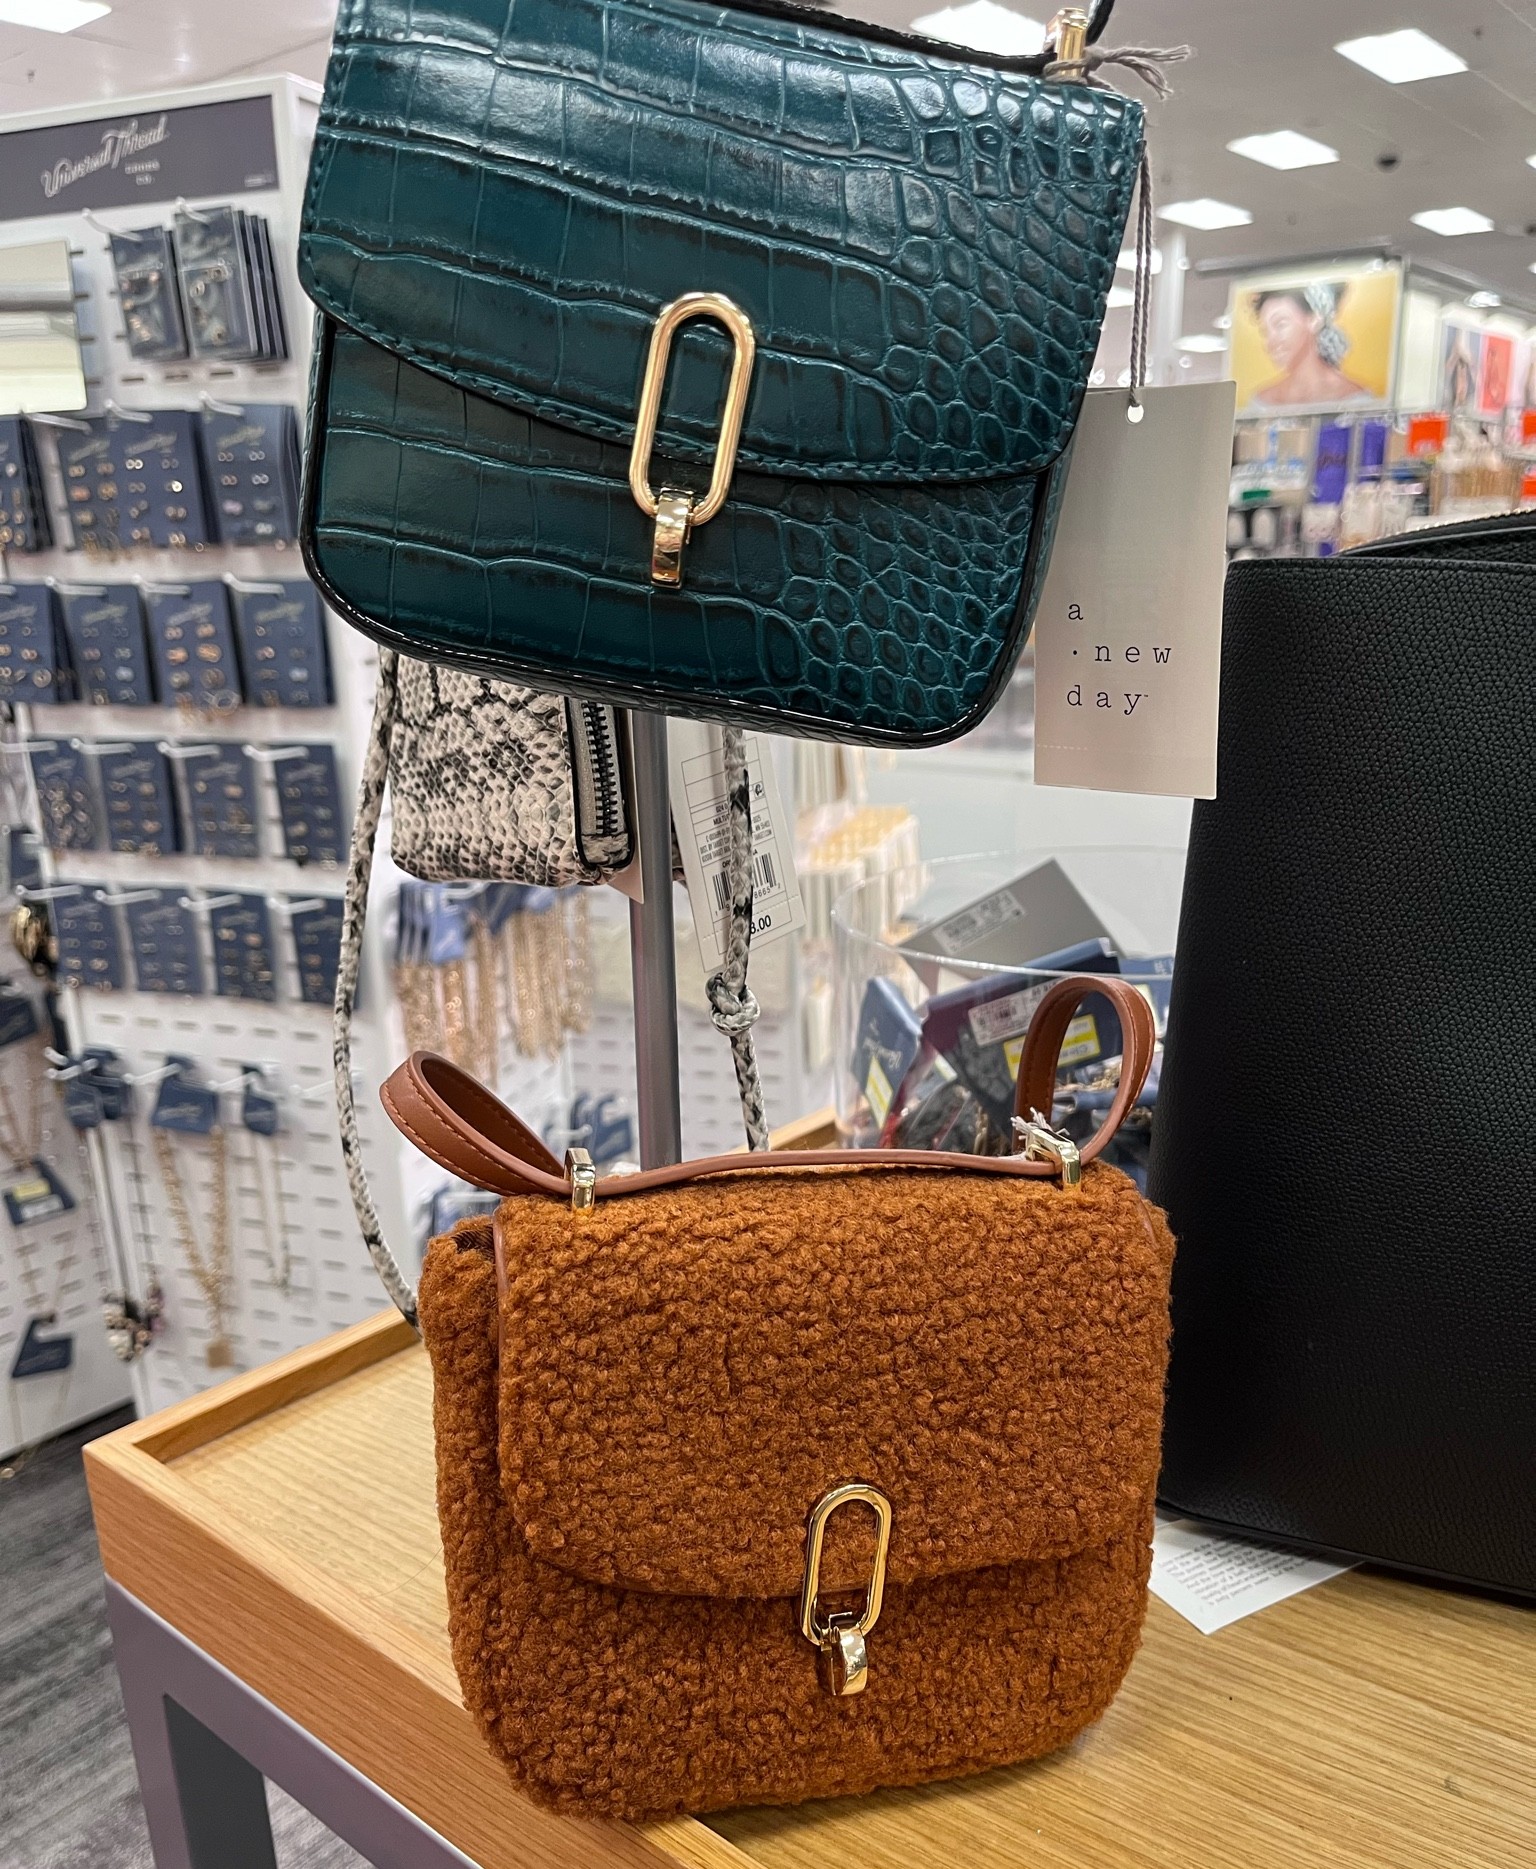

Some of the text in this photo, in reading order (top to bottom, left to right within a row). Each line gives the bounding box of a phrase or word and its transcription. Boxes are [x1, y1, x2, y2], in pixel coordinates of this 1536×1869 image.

[41, 113, 168, 198] Universal Thread
[1068, 604, 1084, 620] a
[1095, 645, 1172, 664] new
